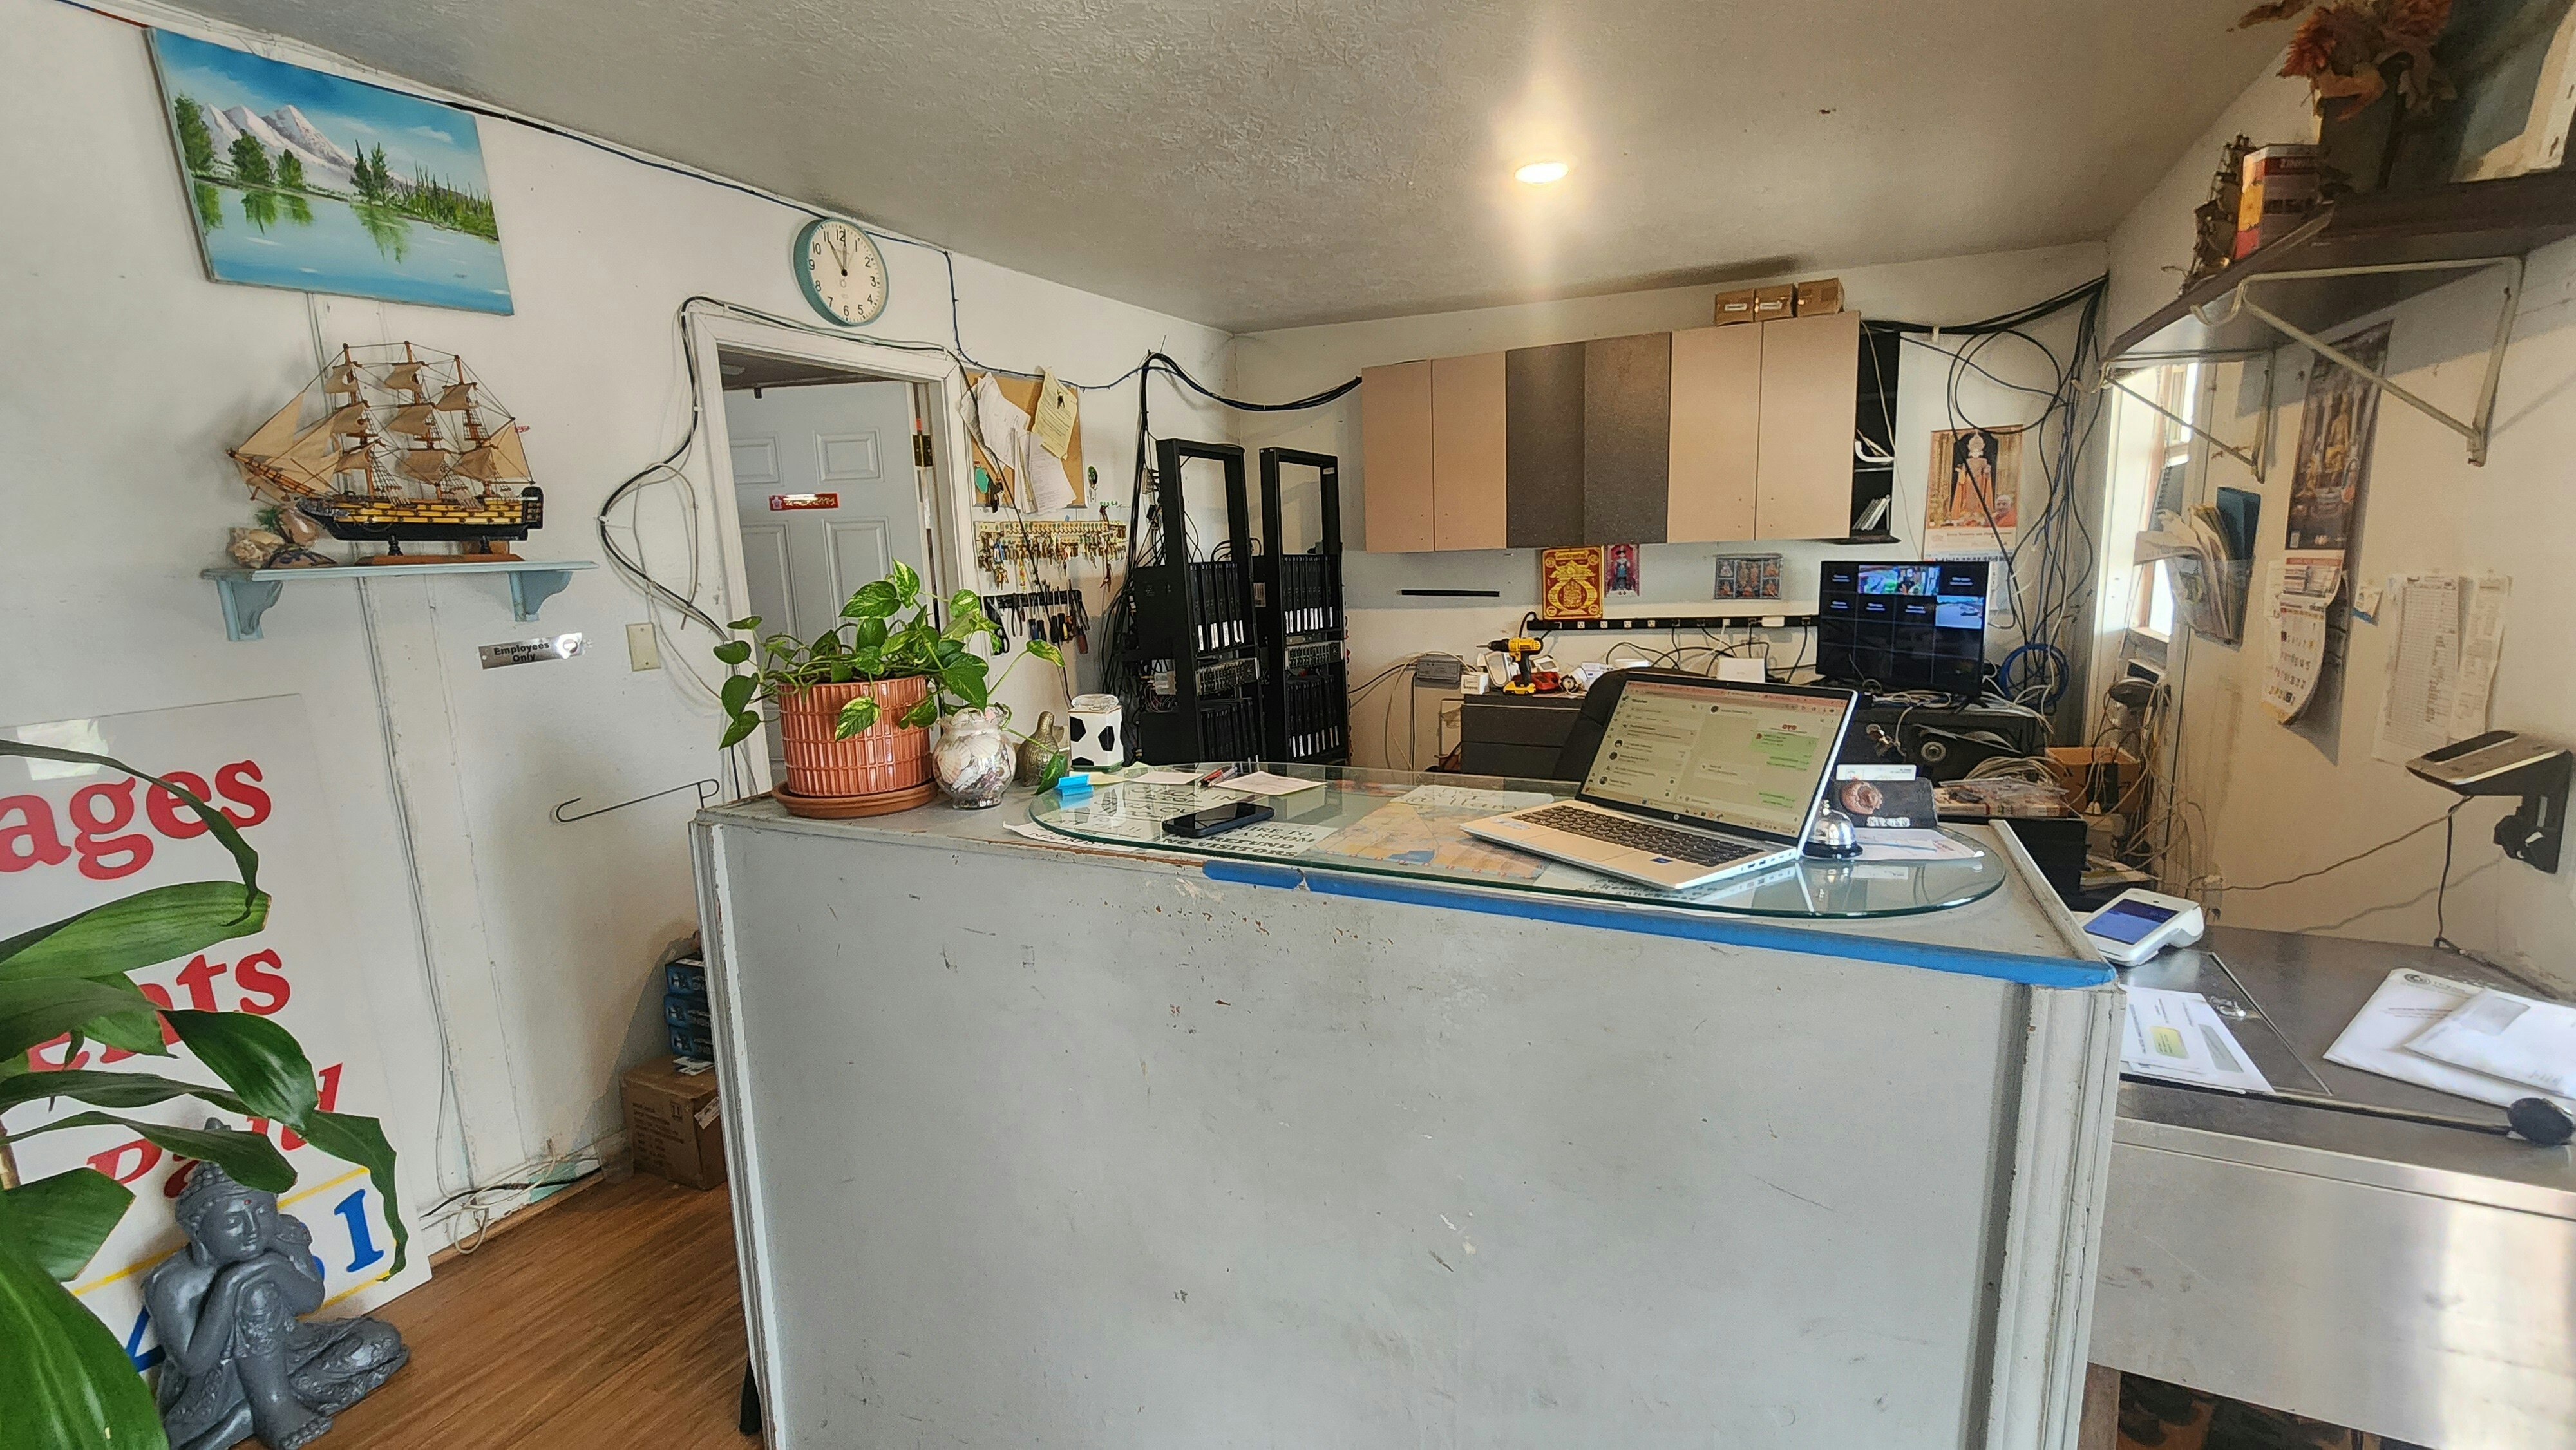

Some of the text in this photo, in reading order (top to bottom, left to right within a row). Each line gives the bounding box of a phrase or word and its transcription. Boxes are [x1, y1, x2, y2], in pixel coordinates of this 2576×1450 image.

[824, 231, 830, 243] 11
[837, 228, 846, 243] 12
[812, 241, 822, 255] 10
[855, 240, 858, 252] 1
[809, 259, 815, 270] 9
[865, 256, 871, 268] 2
[815, 280, 822, 292] 8
[870, 276, 876, 287] 3
[828, 296, 833, 308] 7
[867, 294, 873, 305] 4
[844, 305, 849, 317] 6
[858, 305, 864, 315] 5
[493, 642, 550, 655] Employees
[512, 652, 536, 663] Only
[1206, 836, 1296, 849] REFUND
[1256, 833, 1315, 843] ROOM
[1197, 841, 1298, 857] VISITORS
